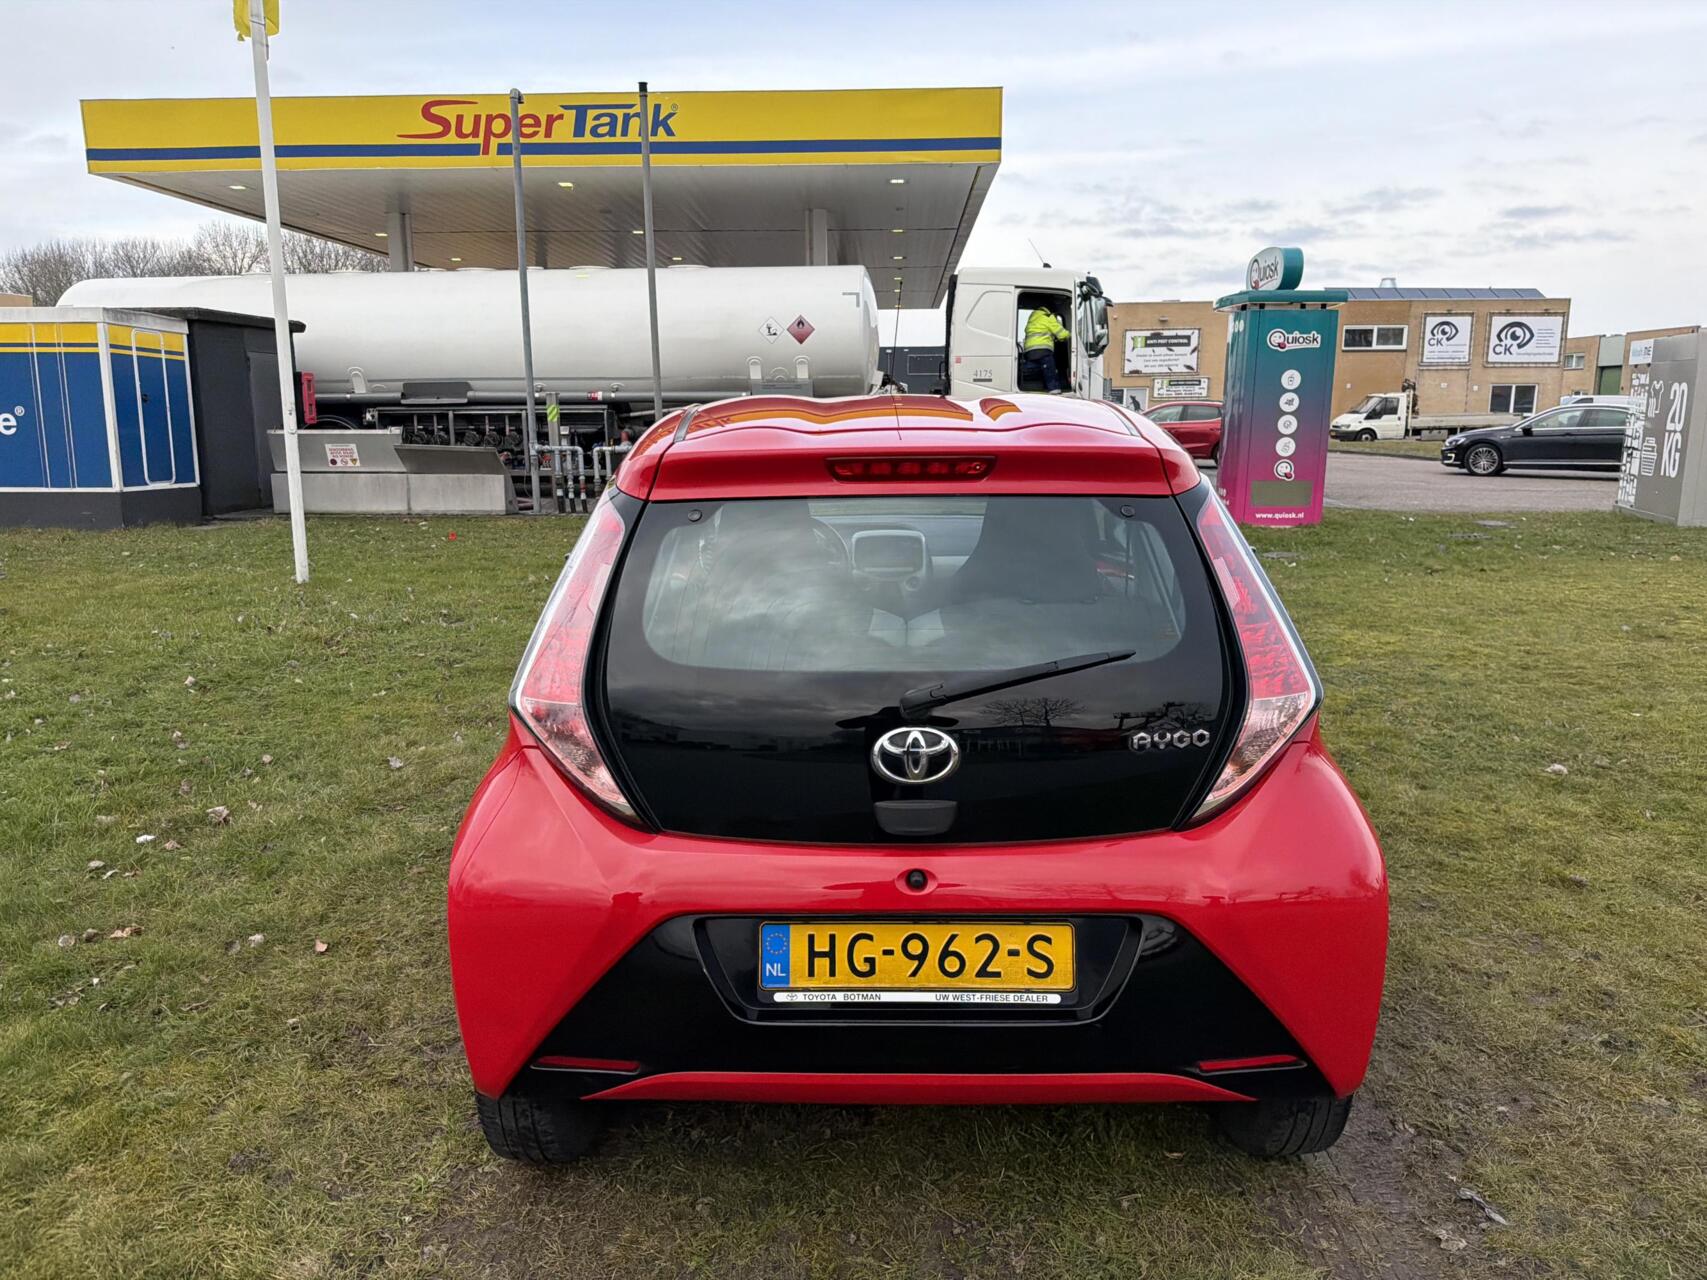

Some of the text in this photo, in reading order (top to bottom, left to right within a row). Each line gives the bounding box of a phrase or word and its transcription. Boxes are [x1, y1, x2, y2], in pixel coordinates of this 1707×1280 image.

[1250, 256, 1279, 290] Quiosk
[1268, 330, 1320, 350] Quiosk
[1428, 337, 1444, 347] CK
[1492, 343, 1514, 356] CK
[973, 369, 992, 378] 4175
[1665, 381, 1688, 432] 20
[1660, 431, 1682, 478] KG
[1255, 511, 1305, 520] www.quiosk.nl
[1132, 728, 1210, 750] AYGO
[807, 932, 1055, 979] HG-962-S
[765, 963, 786, 977] NL
[803, 993, 882, 1001] TOYOTA BOTMAN
[935, 993, 1048, 1003] UW WEST-FRIESE DEALER
